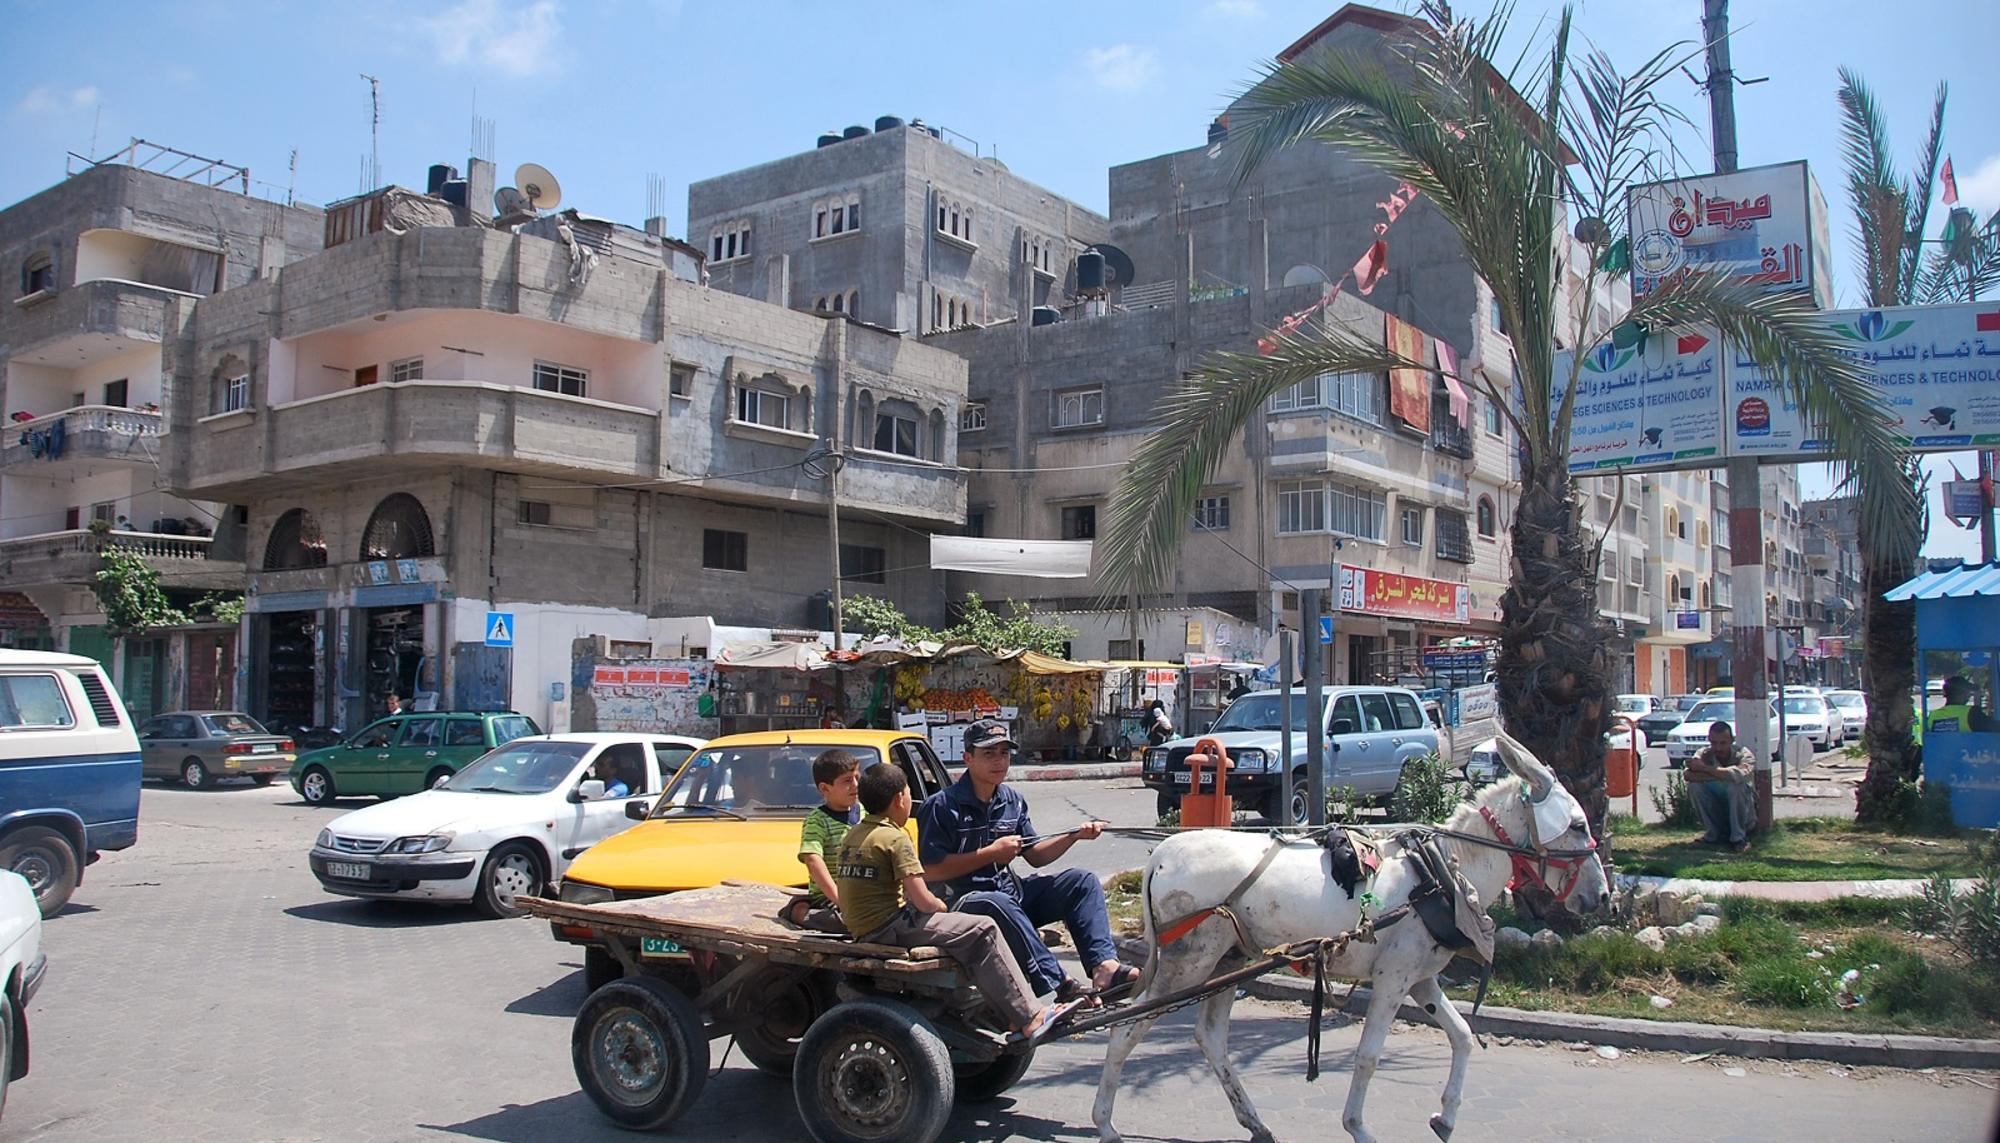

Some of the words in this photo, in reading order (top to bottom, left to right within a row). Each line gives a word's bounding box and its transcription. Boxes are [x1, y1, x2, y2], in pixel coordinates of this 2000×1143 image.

[1668, 188, 1772, 238] ميدان
[1922, 340, 1970, 361] نماء
[1639, 365, 1674, 386] نماء
[1677, 358, 1713, 381] كلية
[1599, 373, 1637, 395] للعلوم
[1592, 398, 1636, 415] SCIENCES
[1646, 386, 1713, 406] TECHNOLOGY
[1375, 573, 1407, 602] الشرق
[1407, 579, 1427, 605] فجر
[1427, 580, 1450, 608] شركة
